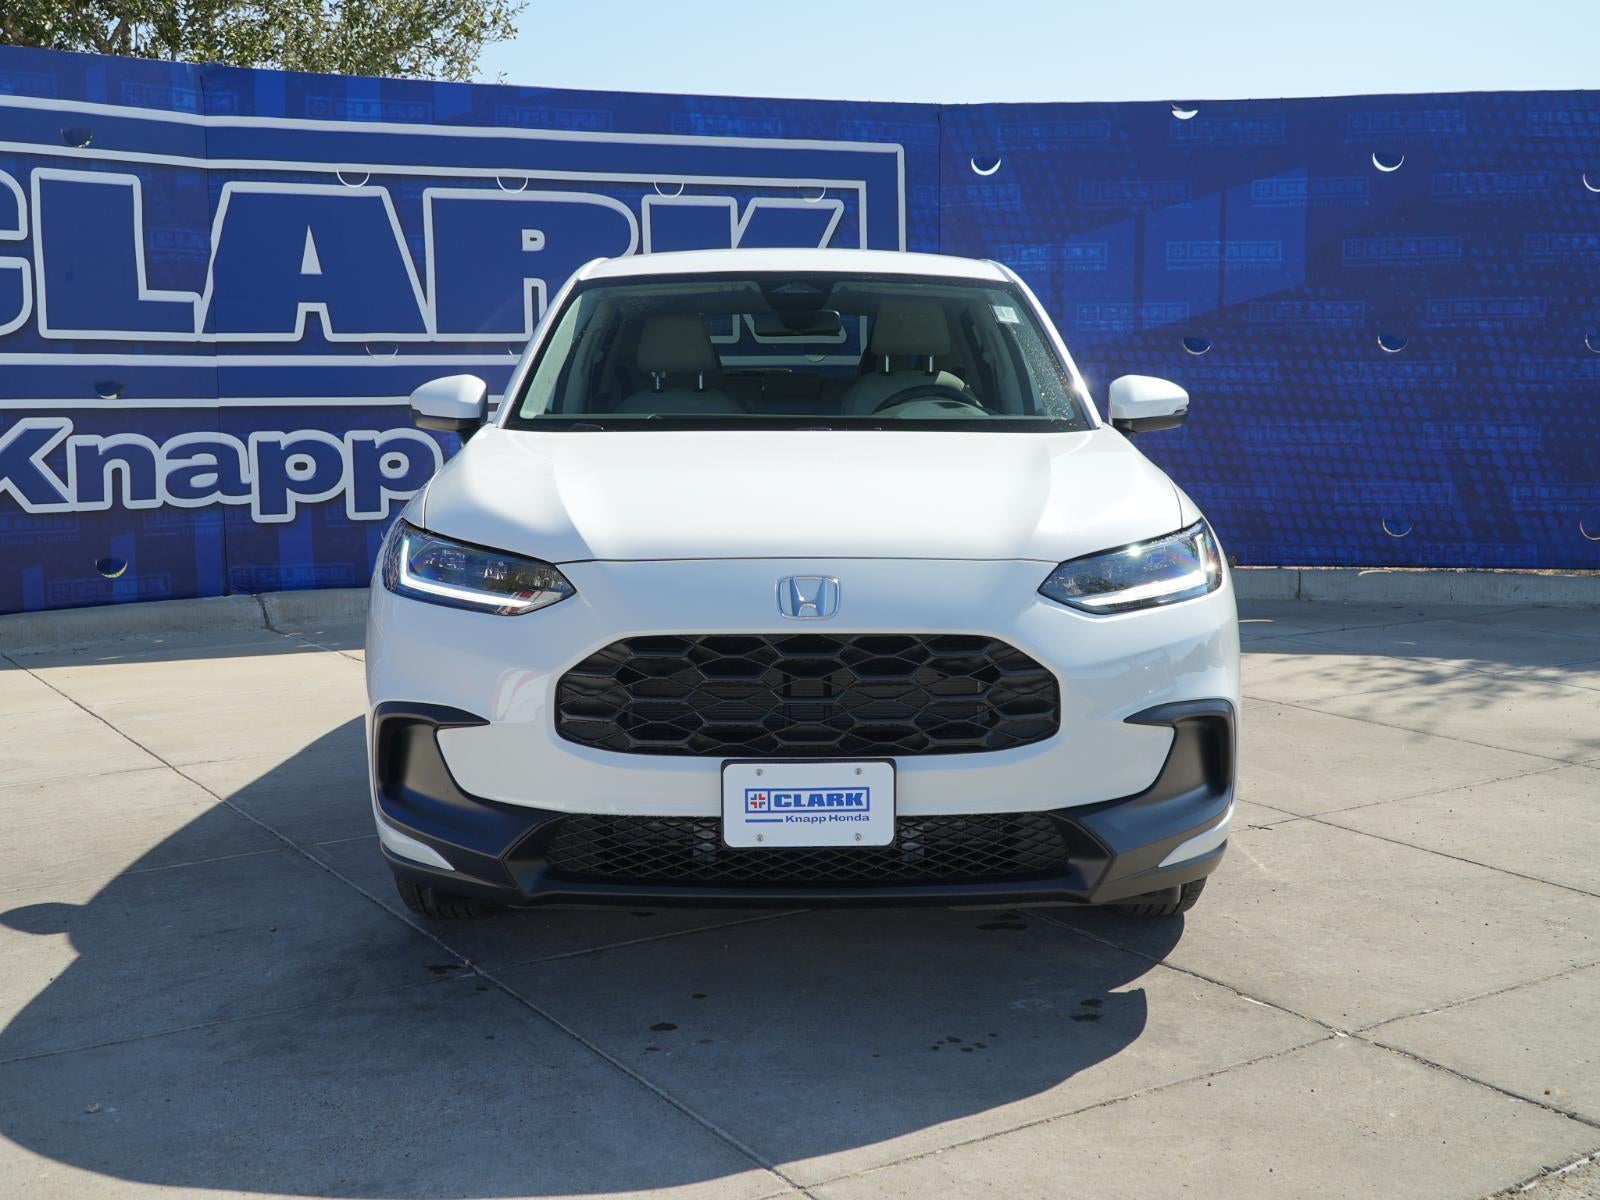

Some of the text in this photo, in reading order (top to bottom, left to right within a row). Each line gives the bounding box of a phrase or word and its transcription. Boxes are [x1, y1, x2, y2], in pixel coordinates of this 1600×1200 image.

[774, 792, 863, 808] CLARK
[785, 814, 870, 825] Knapp Honda
